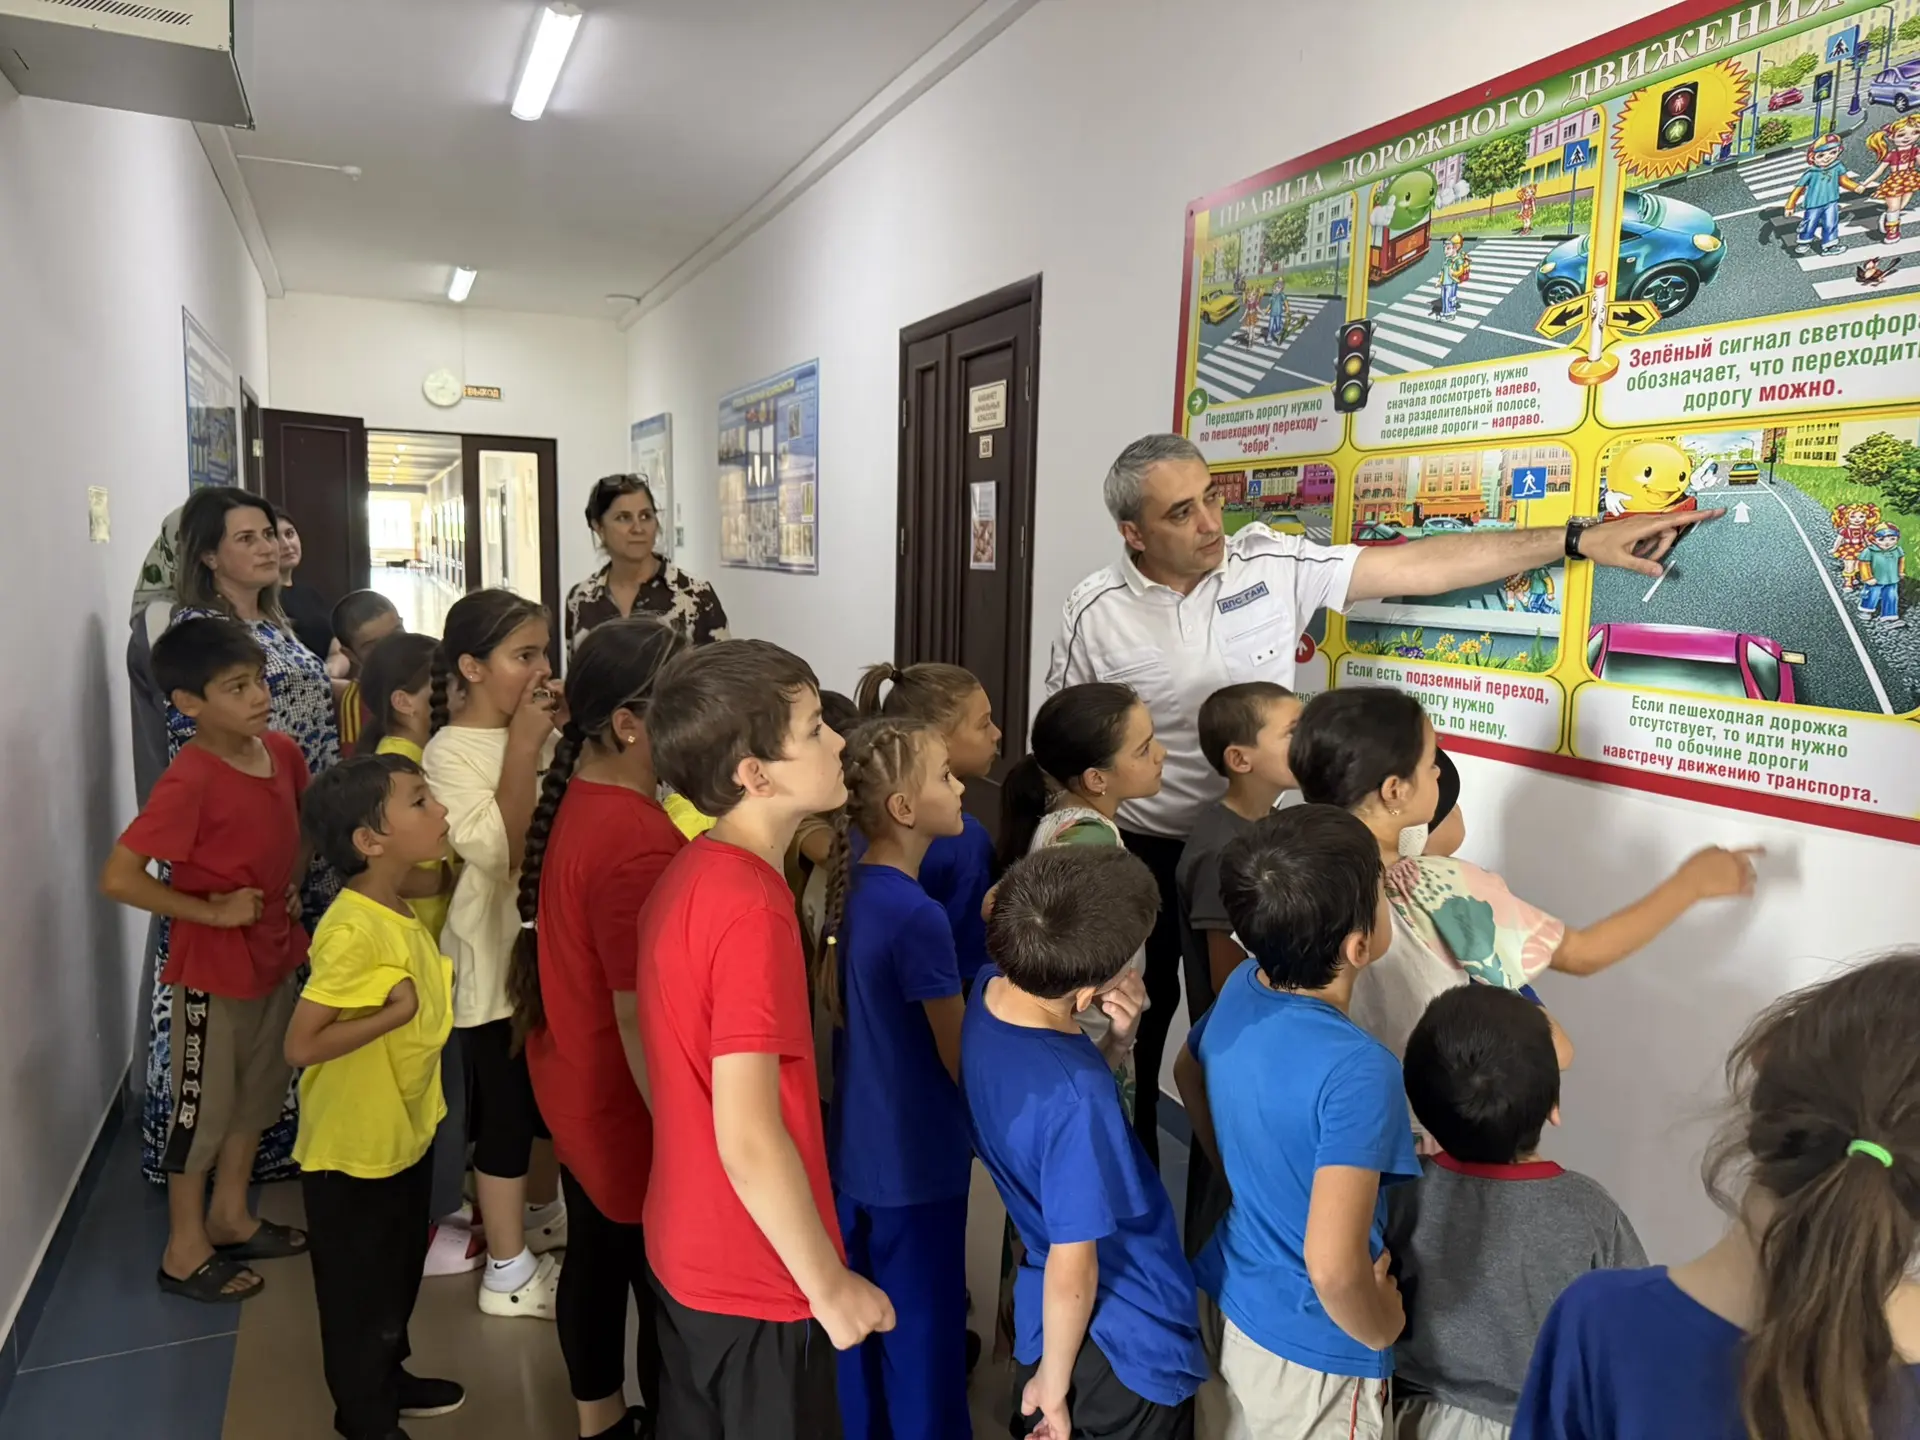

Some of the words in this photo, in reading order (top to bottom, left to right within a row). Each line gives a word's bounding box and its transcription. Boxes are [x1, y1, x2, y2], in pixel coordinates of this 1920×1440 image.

[1219, 171, 1325, 228] ПРАВИЛА
[1337, 88, 1546, 187] ДОРОЖНОГО
[1629, 337, 1712, 368] Зелёный
[1719, 331, 1791, 357] сигнал
[1799, 313, 1920, 345] светофор
[1400, 378, 1447, 395] Переходя
[1451, 372, 1489, 389] дорогу,
[1493, 366, 1528, 385] нужно
[1626, 363, 1740, 392] обозначает,
[1750, 358, 1783, 376] что
[1792, 341, 1920, 374] переходит
[1387, 396, 1426, 411] сначала
[1430, 389, 1492, 407] посмотреть
[1495, 381, 1541, 397] налево,
[1684, 387, 1752, 412] дорогу
[1759, 379, 1843, 402] можно.
[1205, 411, 1254, 427] Переходить
[1256, 404, 1288, 421] дорогу
[1291, 399, 1322, 416] нужно
[1381, 422, 1438, 440] посередине
[1441, 419, 1478, 436] дороги
[1492, 413, 1544, 430] направо.
[1385, 414, 1391, 424] а
[1393, 413, 1405, 424] на
[1408, 400, 1493, 425] разделительной
[1496, 398, 1541, 413] полосе,
[1200, 432, 1209, 442] по
[1211, 424, 1271, 441] пешеходному
[1272, 416, 1318, 434] переходу
[1222, 597, 1243, 610] ДПС
[1244, 586, 1265, 600] ГАИ
[1347, 661, 1373, 678] Если
[1377, 666, 1402, 682] есть
[1406, 670, 1481, 693] подземный
[1486, 680, 1549, 705] переход,
[1453, 695, 1494, 716] нужно
[1632, 695, 1664, 713] Если
[1669, 704, 1764, 726] пешеходная
[1769, 716, 1848, 738] дорожка
[1450, 716, 1465, 730] по
[1470, 720, 1507, 739] нему.
[1629, 714, 1716, 741] отсутствует,
[1723, 728, 1740, 742] то
[1746, 732, 1784, 749] идти
[1791, 738, 1848, 758] нужно
[1655, 735, 1673, 749] по
[1678, 737, 1742, 761] обочине
[1748, 751, 1809, 772] дороги
[1603, 745, 1673, 769] навстречу
[1678, 757, 1760, 783] движению
[1767, 772, 1879, 804] транспорта.
